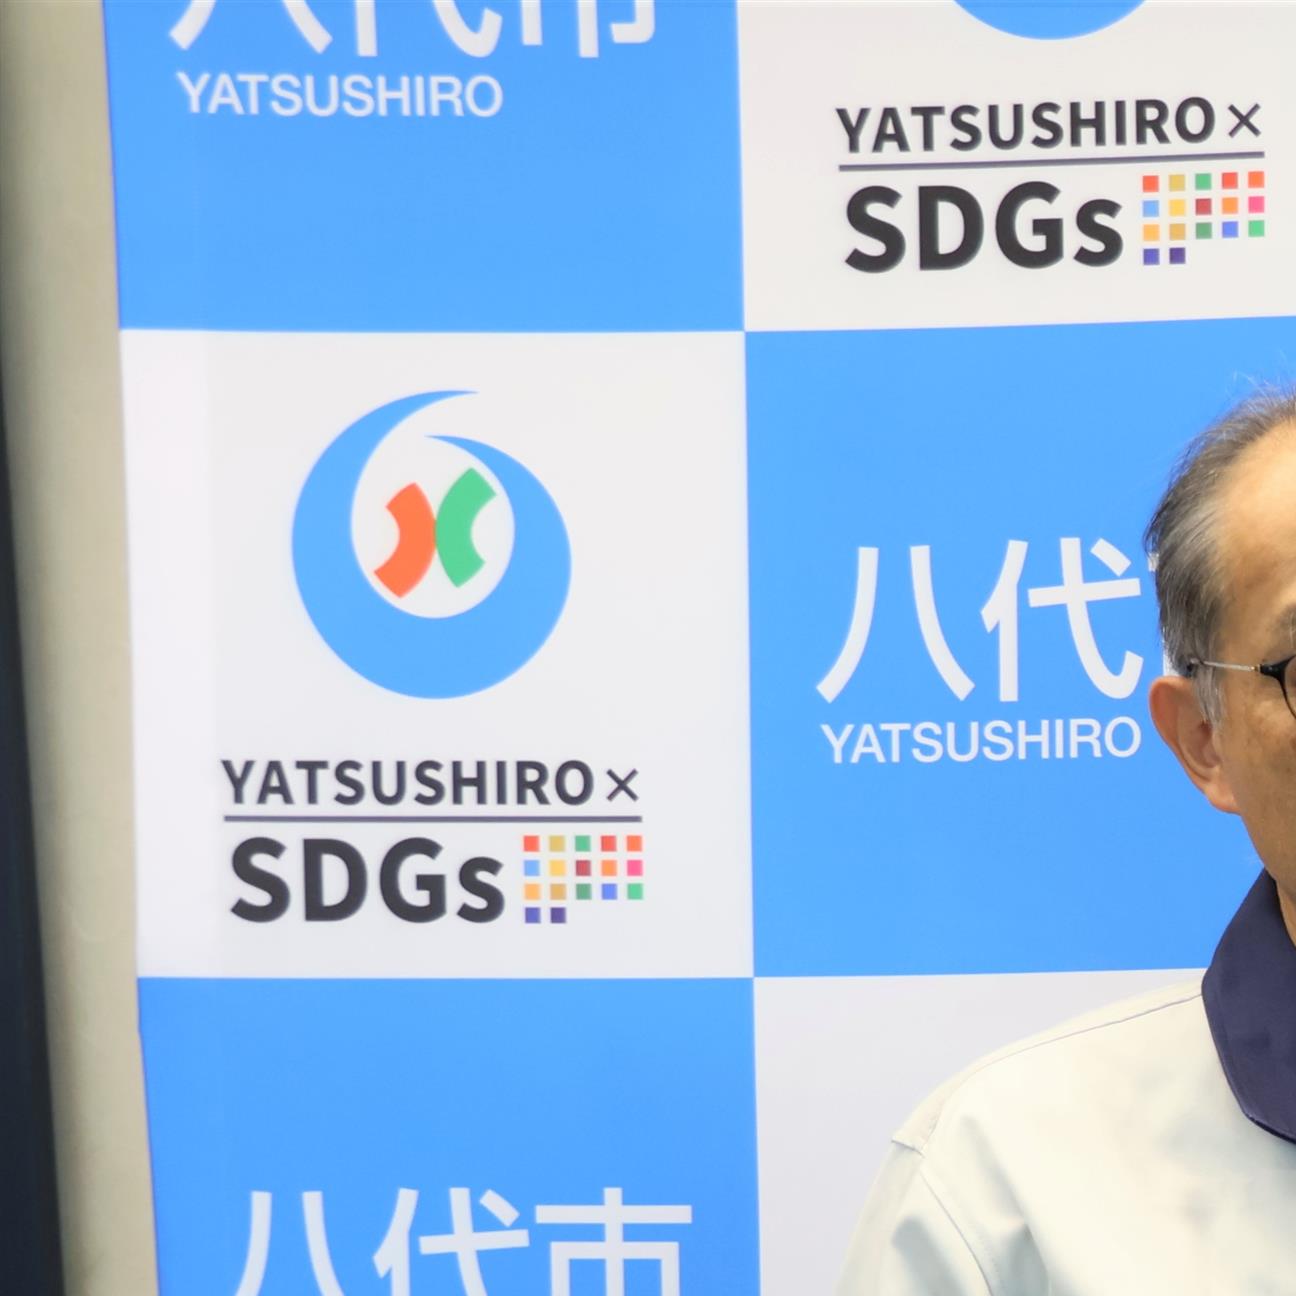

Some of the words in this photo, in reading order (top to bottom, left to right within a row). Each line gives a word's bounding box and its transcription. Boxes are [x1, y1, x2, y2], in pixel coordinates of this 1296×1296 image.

[178, 73, 503, 118] YATSUSHIRO
[846, 182, 1123, 274] SDGs
[816, 537, 1178, 703] 八代
[823, 718, 1142, 764] YATSUSHIRO
[232, 838, 505, 924] SDGs
